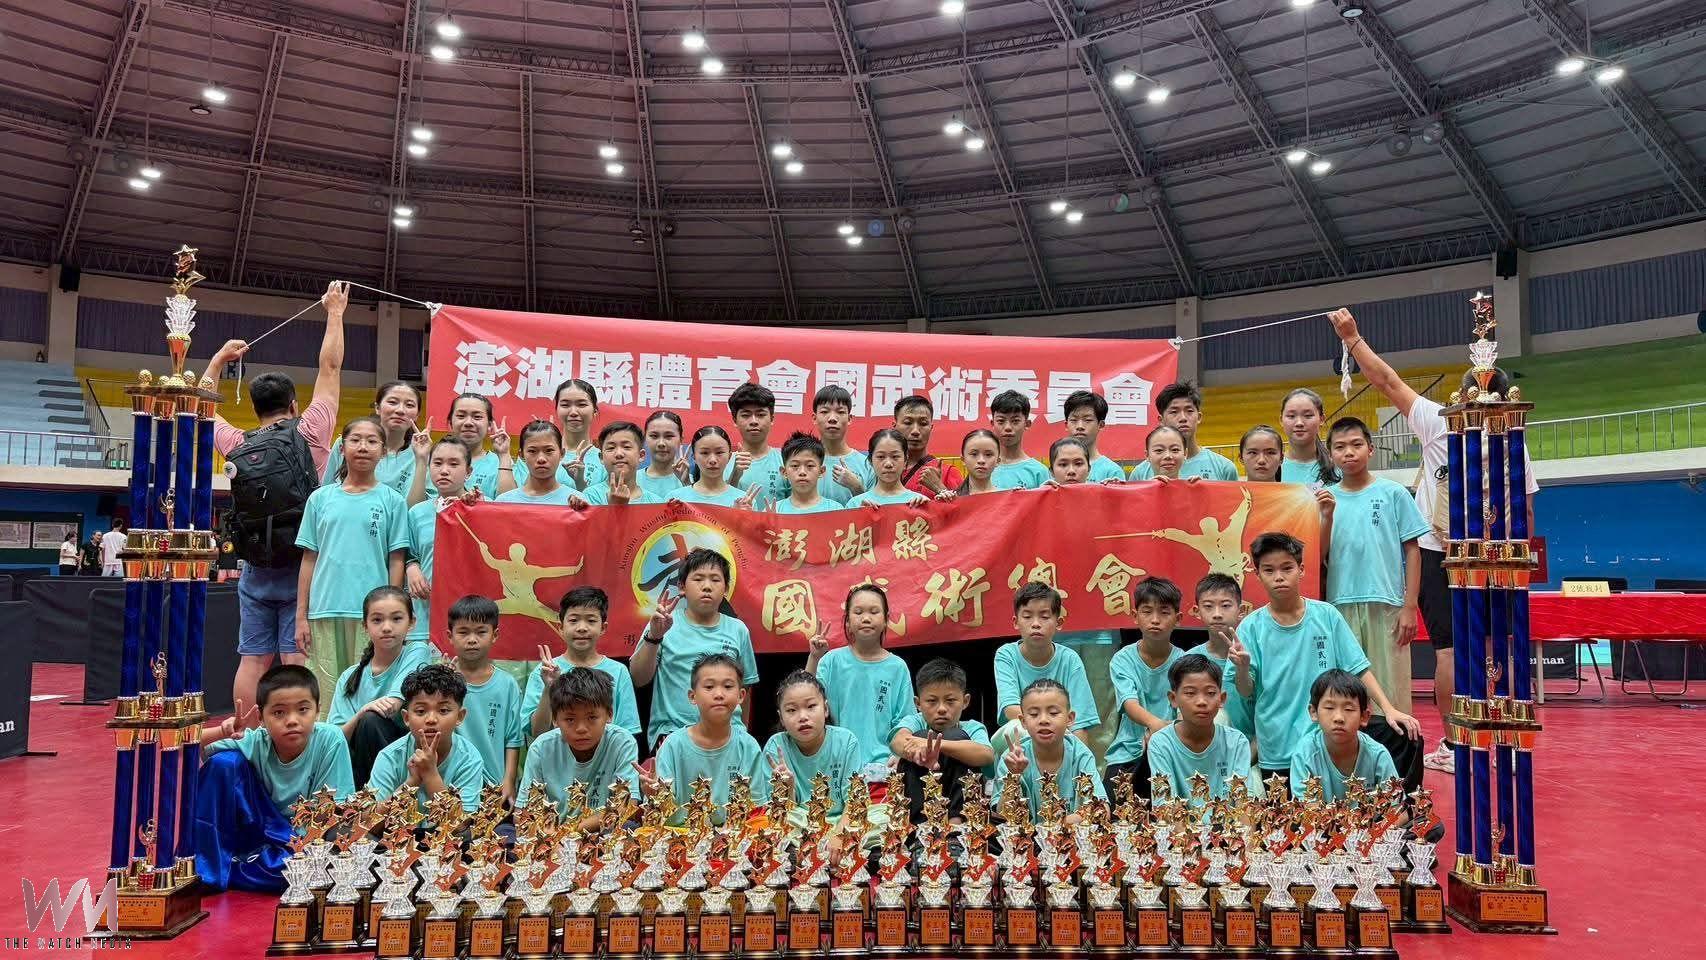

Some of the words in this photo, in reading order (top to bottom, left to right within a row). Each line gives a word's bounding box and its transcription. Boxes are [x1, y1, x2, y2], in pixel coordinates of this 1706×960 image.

[453, 340, 1154, 426] 澎湖縣體育會國武術委員會
[764, 517, 939, 571] 澎湖縣
